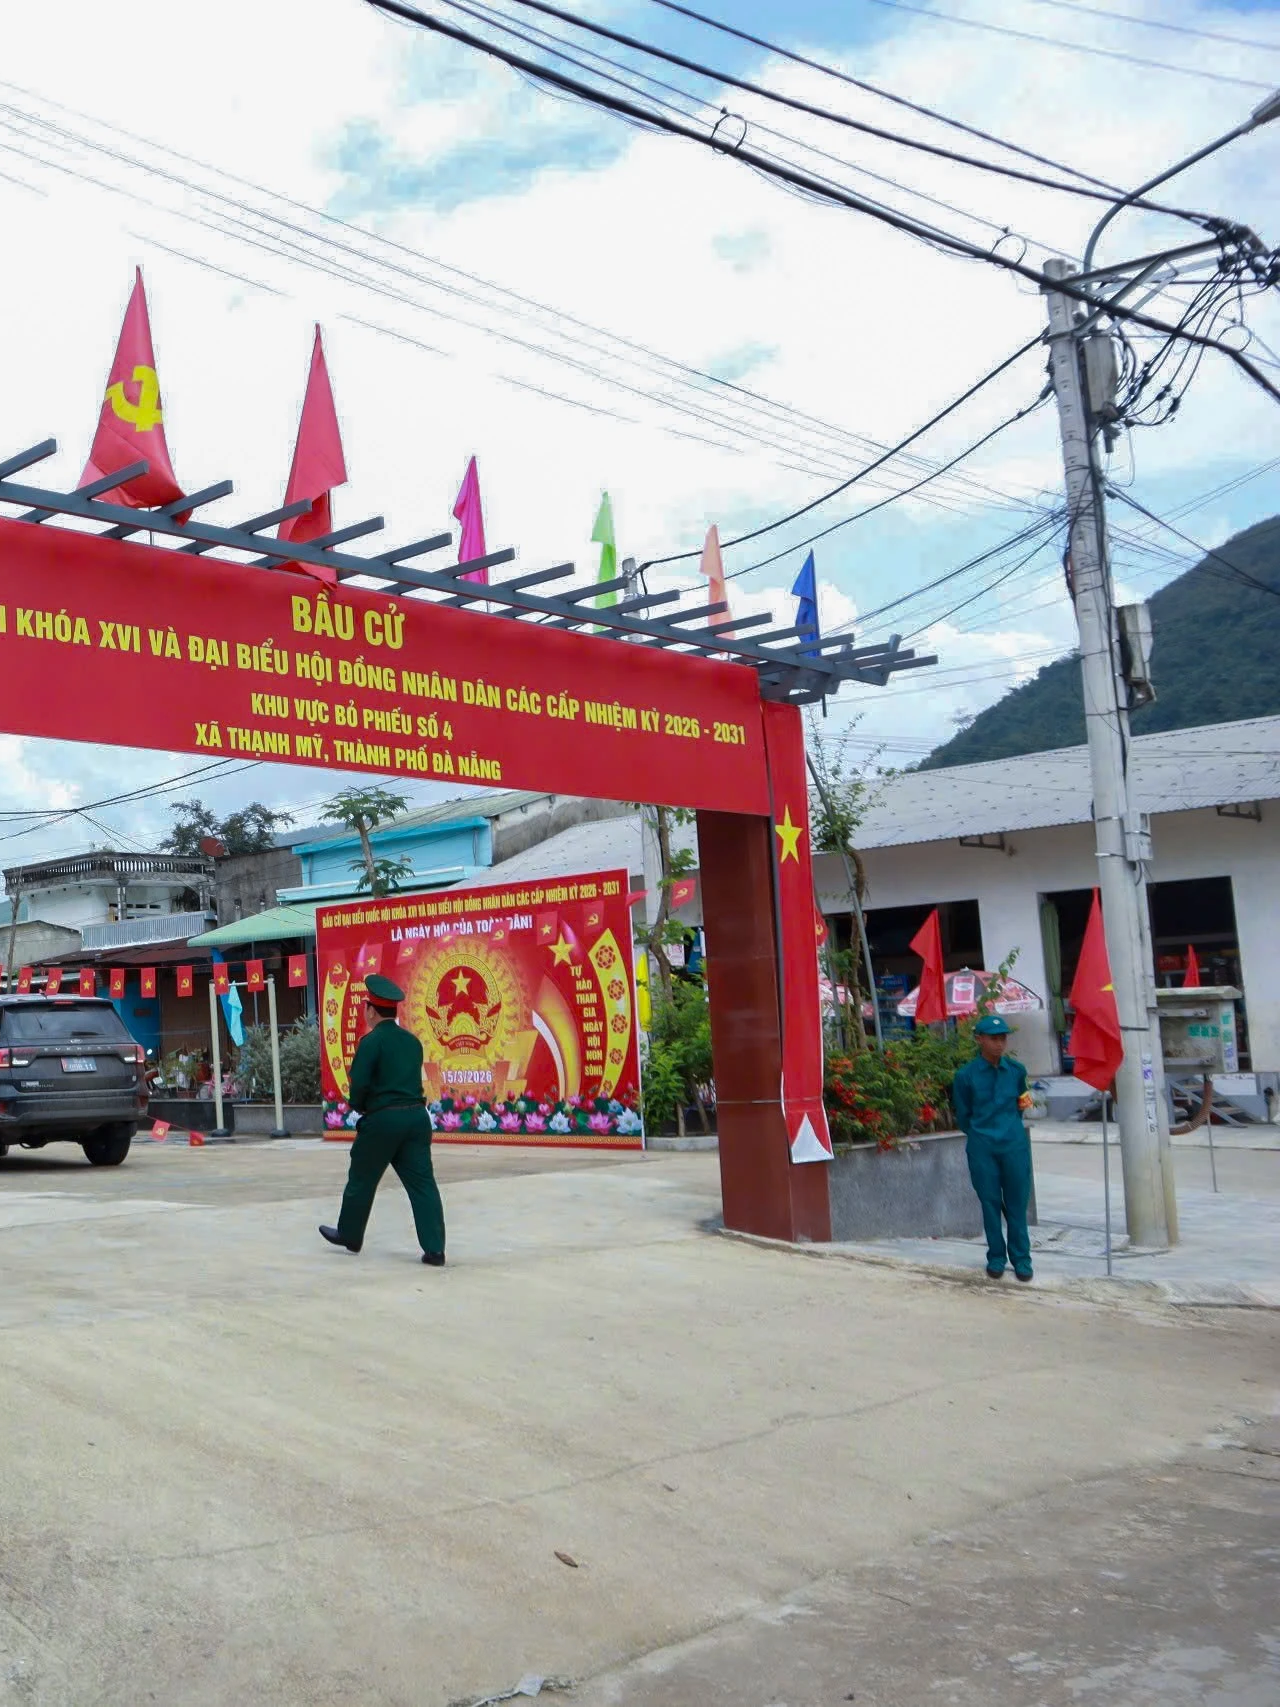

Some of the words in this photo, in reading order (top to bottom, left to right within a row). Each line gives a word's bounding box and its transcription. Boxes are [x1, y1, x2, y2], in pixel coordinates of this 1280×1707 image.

[290, 591, 355, 641] BẦU
[364, 602, 406, 650] CỬ
[16, 608, 92, 646] KHÓA
[98, 620, 141, 653] XVI
[148, 626, 182, 660] VÀ
[188, 634, 230, 671] ĐẠI
[236, 637, 290, 675] BIỂU
[295, 651, 333, 686] HỘI
[338, 654, 397, 693] ĐỒNG
[401, 670, 458, 702] NHÂN
[462, 678, 502, 709] DÂN
[506, 686, 542, 715] CÁC
[546, 690, 580, 720] CẤP
[584, 701, 638, 732] NHIỆM
[640, 707, 660, 733] KỲ
[664, 713, 700, 739] 2026
[713, 721, 746, 745] 2031
[251, 692, 289, 719] KHU
[293, 698, 329, 727] VỰC
[334, 699, 358, 728] BỎ
[363, 706, 412, 735] PHIẾU
[417, 711, 439, 739] SỐ
[443, 720, 454, 741] 4
[195, 720, 222, 748] XÃ
[227, 726, 291, 757] THẠNH
[295, 733, 329, 762] MỸ,
[333, 738, 391, 768] THÀNH
[394, 744, 429, 772] PHỐ
[432, 750, 455, 775] ĐÀ
[457, 750, 502, 780] NẴNG
[516, 889, 530, 906] CÁC
[546, 885, 568, 904] NHIỆM
[580, 884, 597, 899] 2026
[602, 881, 620, 896] 2031
[391, 925, 403, 942] LÀ
[576, 992, 597, 1005] THAM
[583, 1007, 596, 1018] GIA
[583, 1020, 604, 1033] NGÀY
[441, 1070, 492, 1084] 15/3/2026
